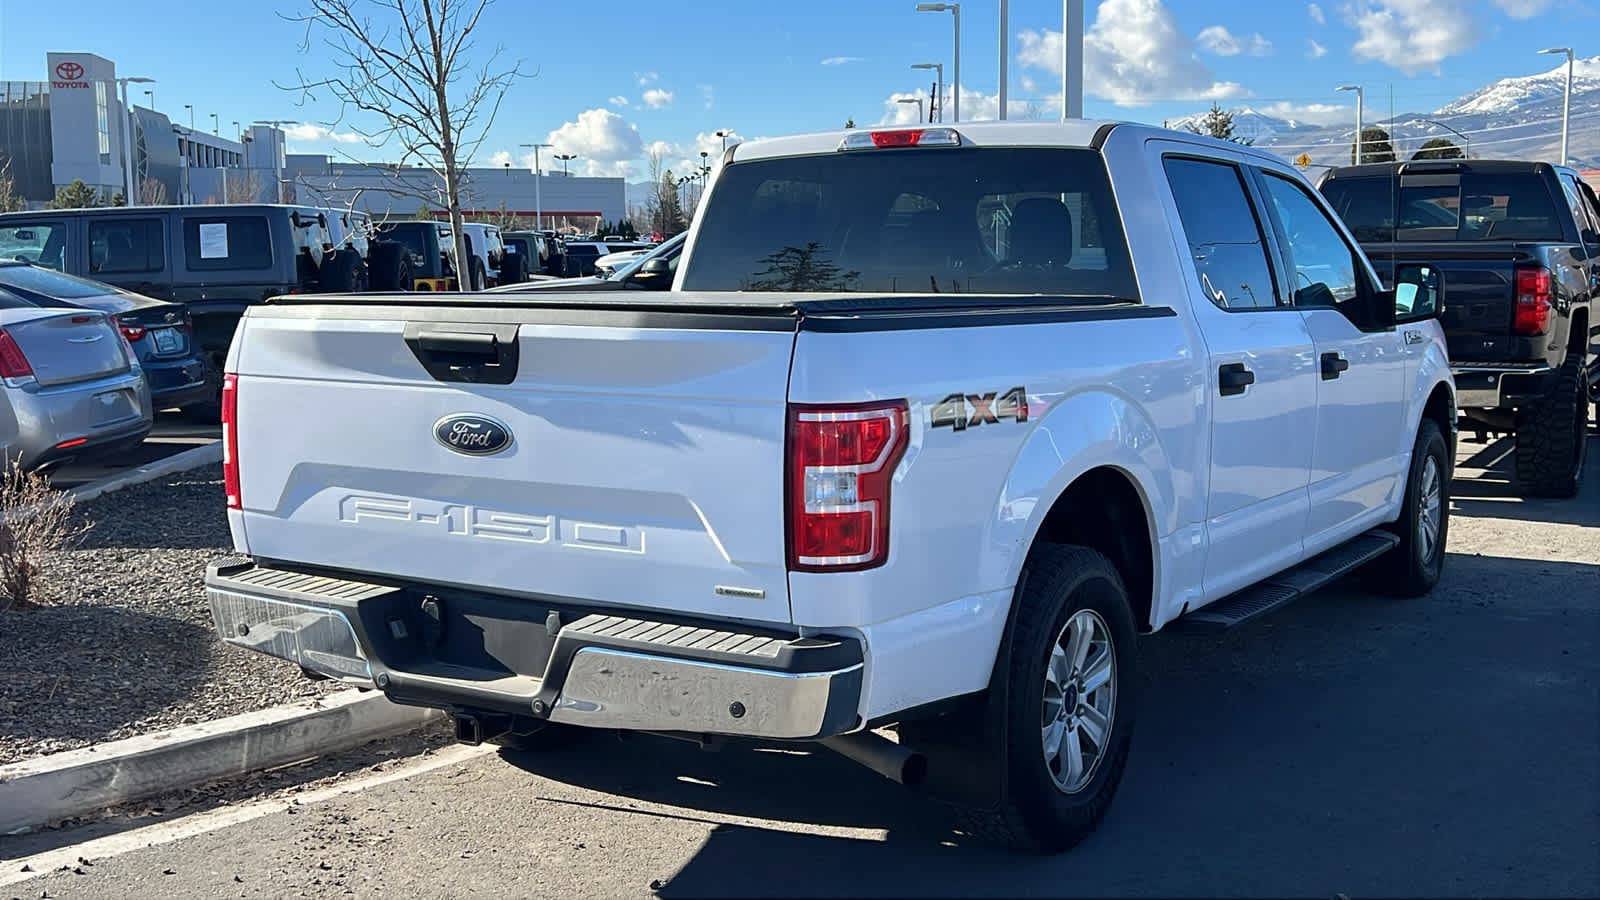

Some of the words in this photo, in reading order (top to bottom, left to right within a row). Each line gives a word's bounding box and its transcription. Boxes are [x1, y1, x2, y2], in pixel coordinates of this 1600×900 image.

[52, 81, 89, 89] TOYOTA
[448, 421, 492, 446] Ford
[338, 494, 646, 554] F-150
